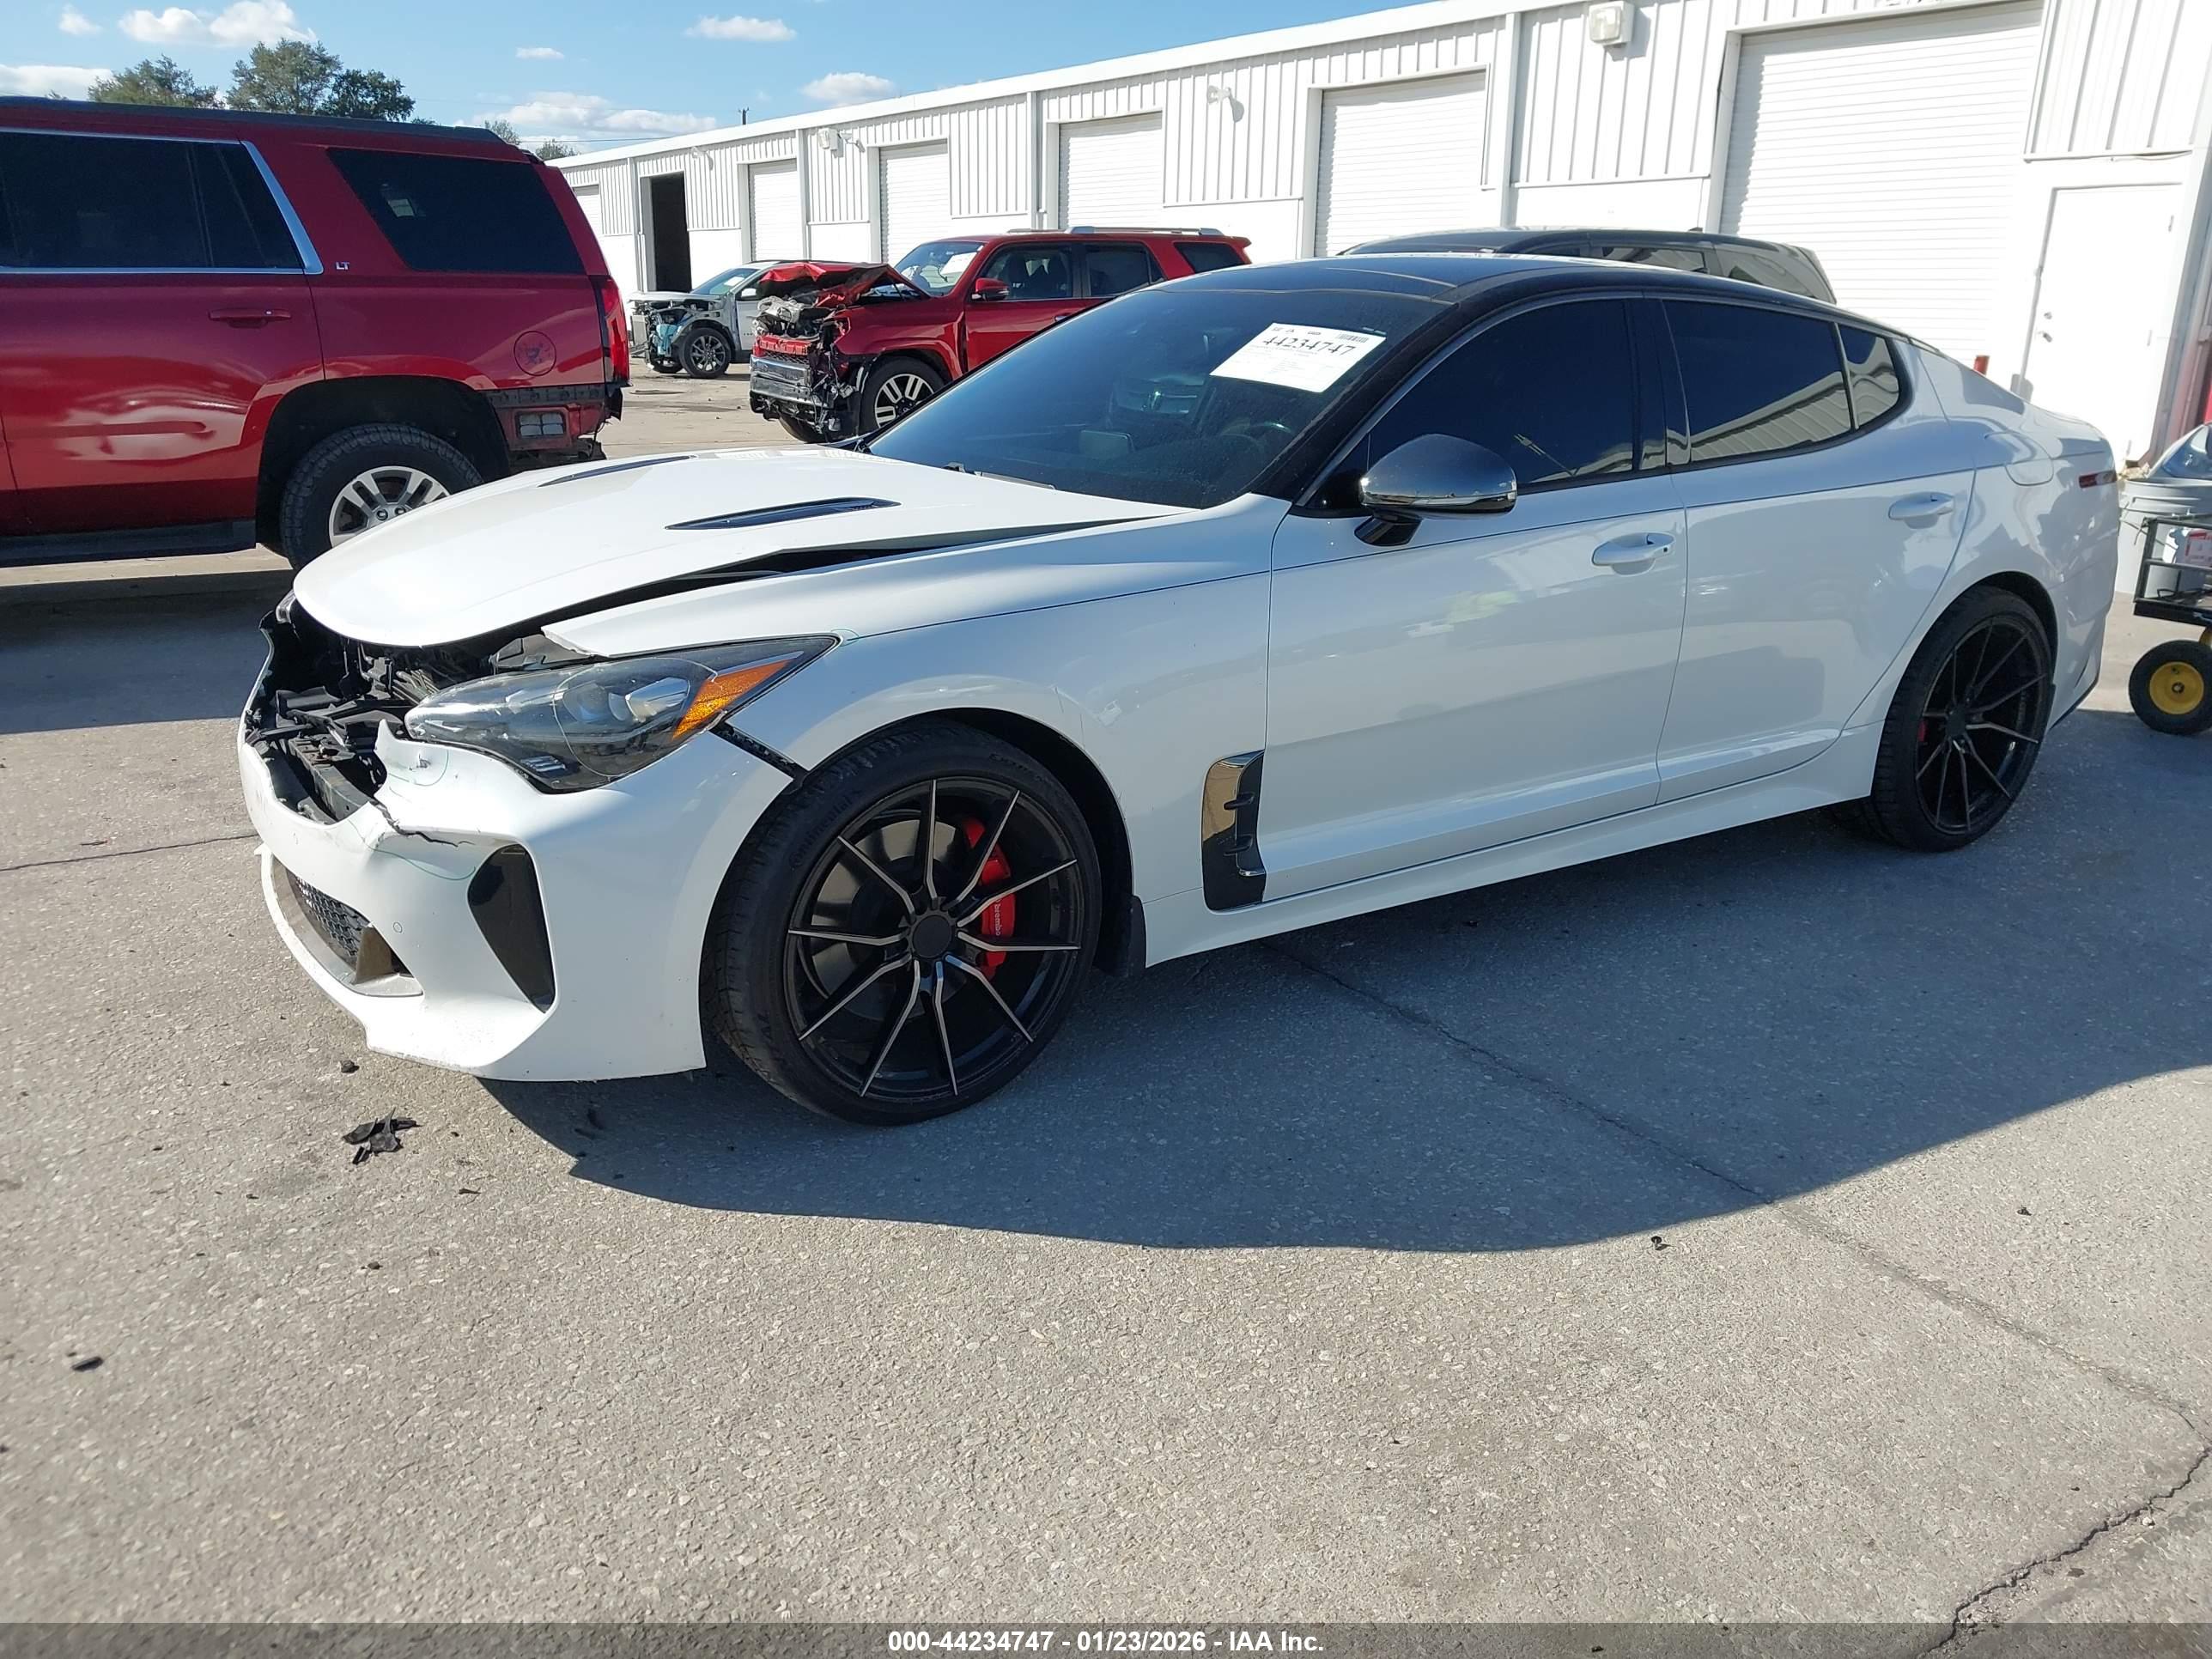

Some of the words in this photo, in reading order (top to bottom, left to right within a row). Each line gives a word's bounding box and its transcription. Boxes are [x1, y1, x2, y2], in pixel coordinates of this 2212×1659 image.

[336, 262, 349, 270] LT
[1263, 336, 1356, 356] 44234747
[994, 903, 1003, 936] brembo
